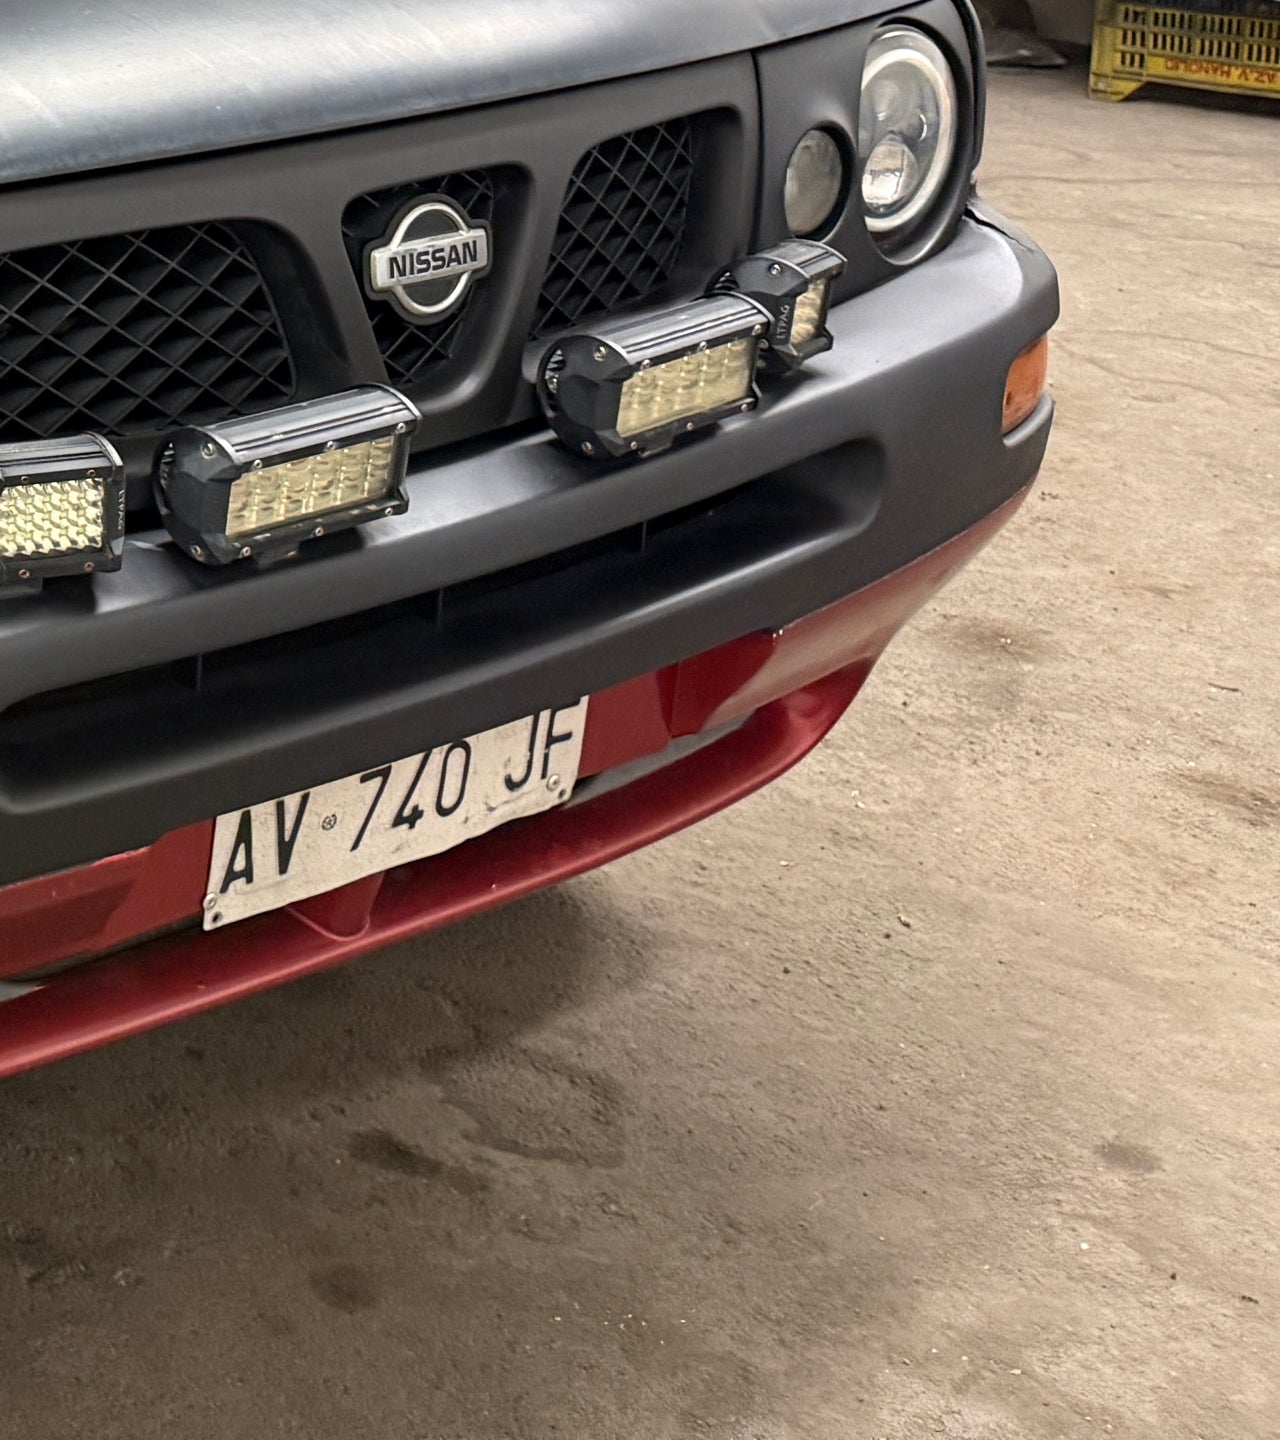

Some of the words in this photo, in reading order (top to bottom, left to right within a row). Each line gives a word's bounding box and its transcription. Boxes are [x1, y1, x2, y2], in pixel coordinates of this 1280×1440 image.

[389, 240, 478, 279] NISSAN
[776, 304, 790, 339] LTPAG
[220, 791, 310, 893] AV
[351, 738, 471, 852] 740
